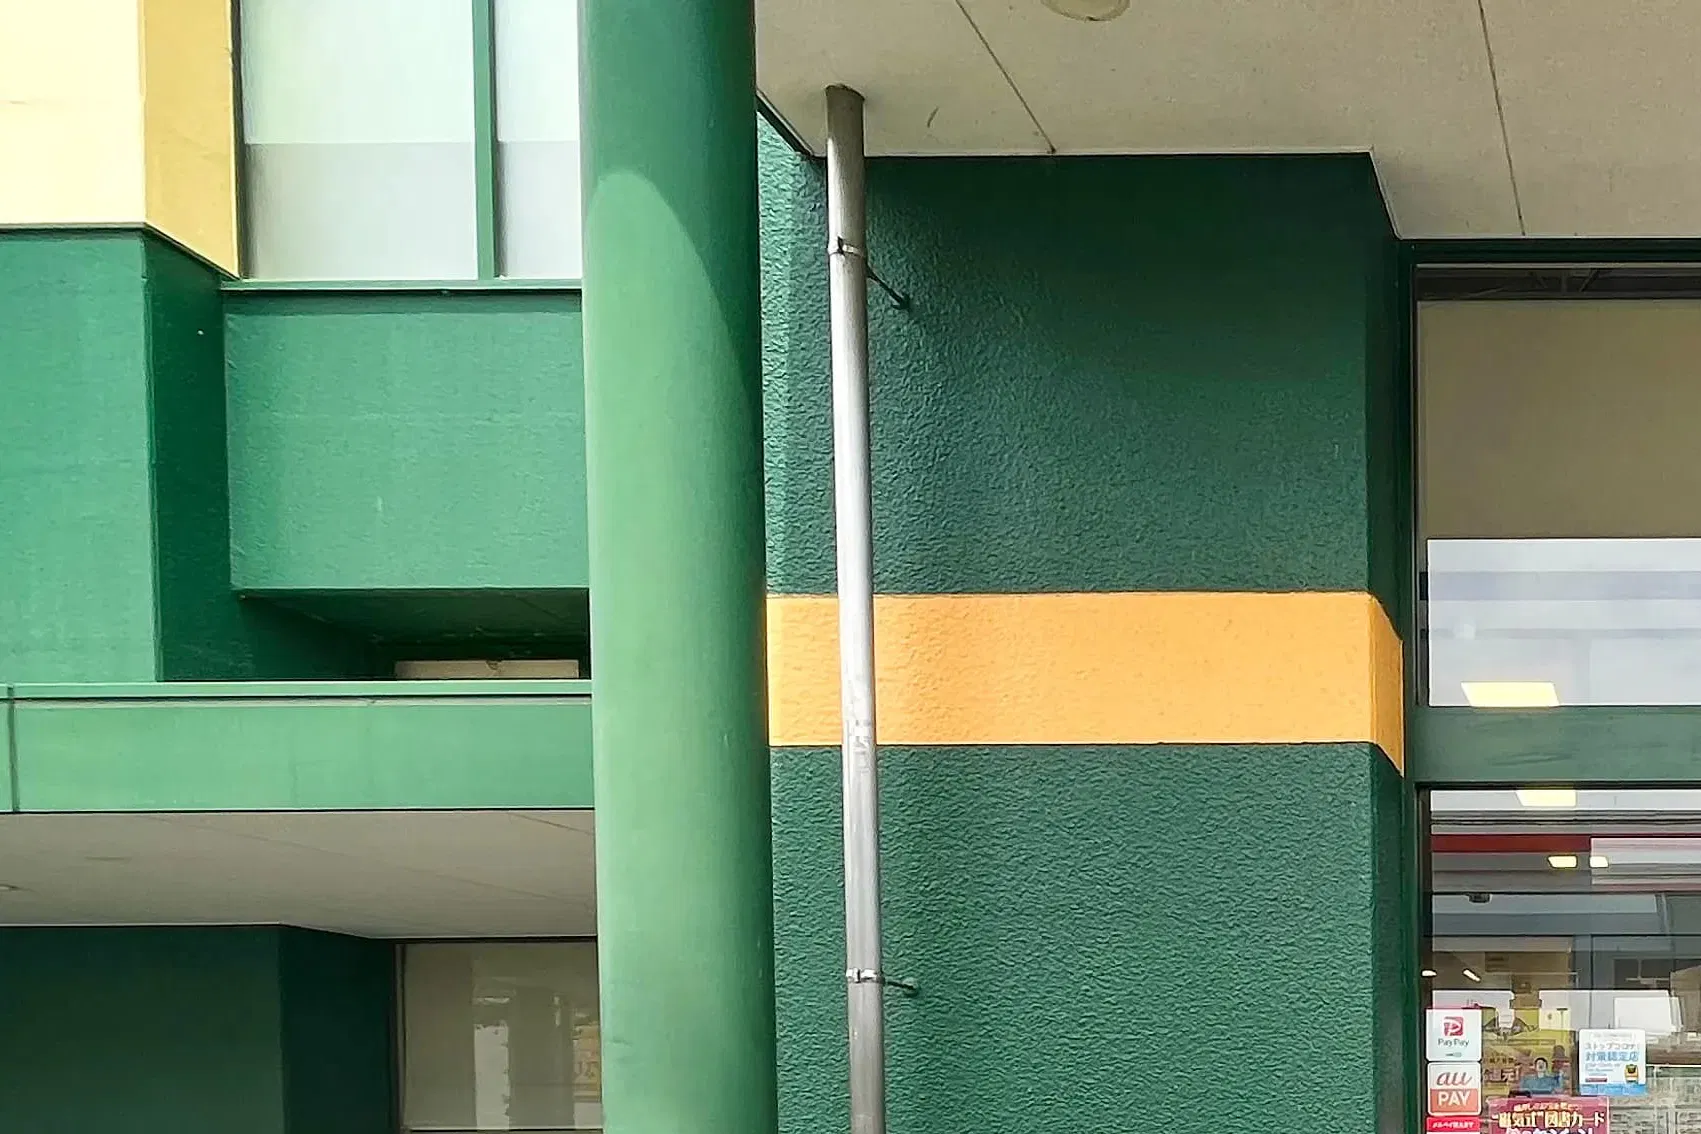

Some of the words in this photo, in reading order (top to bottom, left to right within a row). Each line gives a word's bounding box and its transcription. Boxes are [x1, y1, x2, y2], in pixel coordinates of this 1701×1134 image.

[1437, 1038, 1470, 1048] PayPay
[1585, 1051, 1639, 1062] 対策認定店
[1436, 1071, 1473, 1087] au
[1438, 1090, 1470, 1107] PAY
